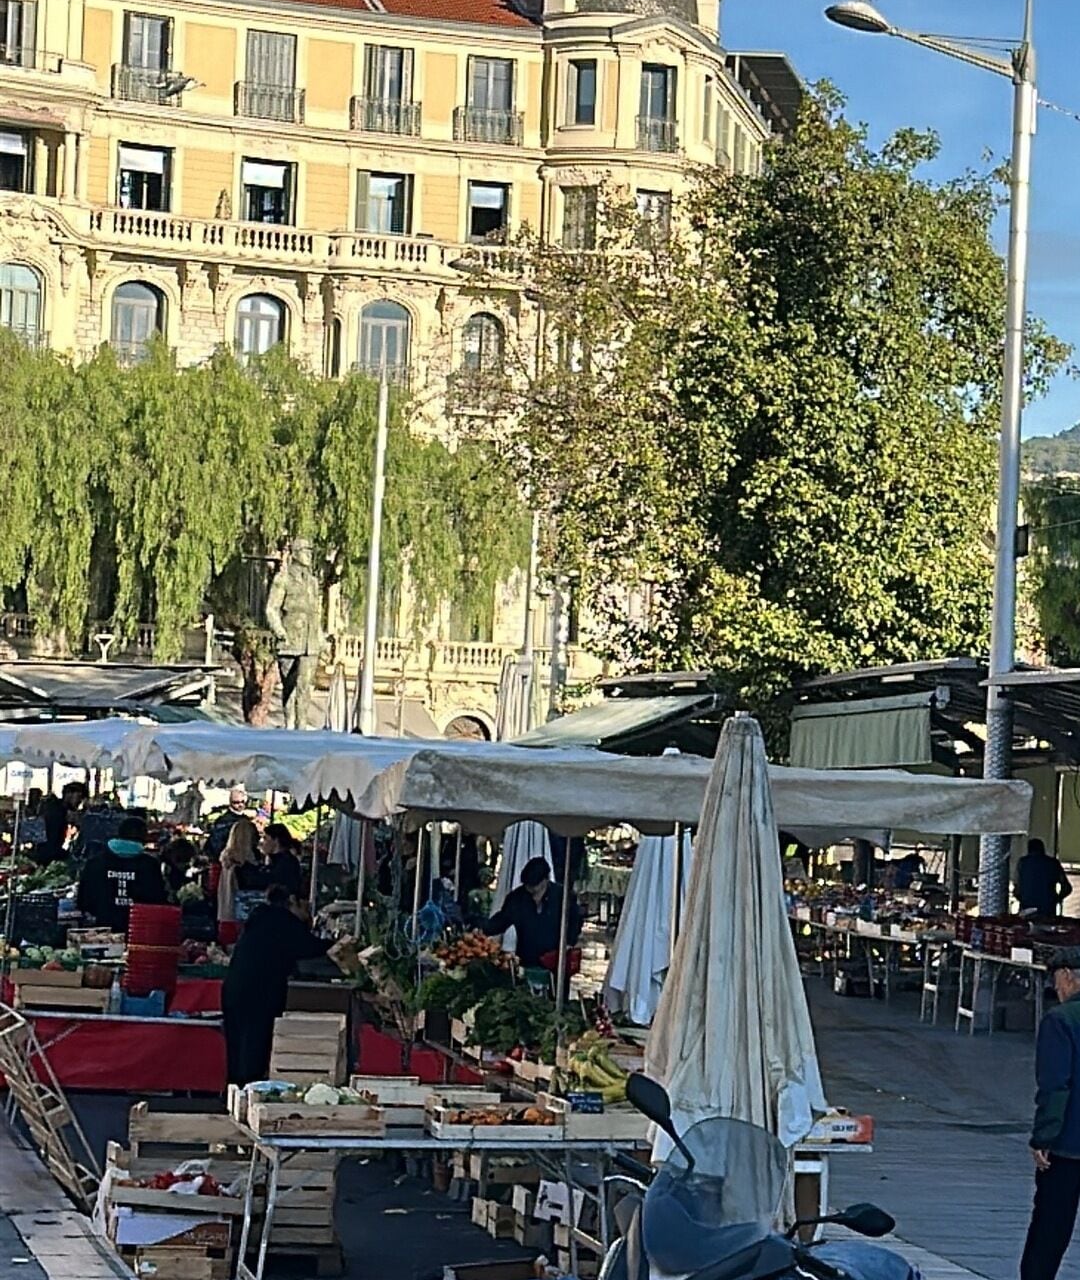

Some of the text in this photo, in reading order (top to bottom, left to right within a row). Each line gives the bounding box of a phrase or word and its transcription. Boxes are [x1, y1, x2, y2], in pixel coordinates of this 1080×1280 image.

[107, 870, 136, 880] CHOOSE
[118, 880, 127, 888] TO
[117, 888, 128, 897] BE
